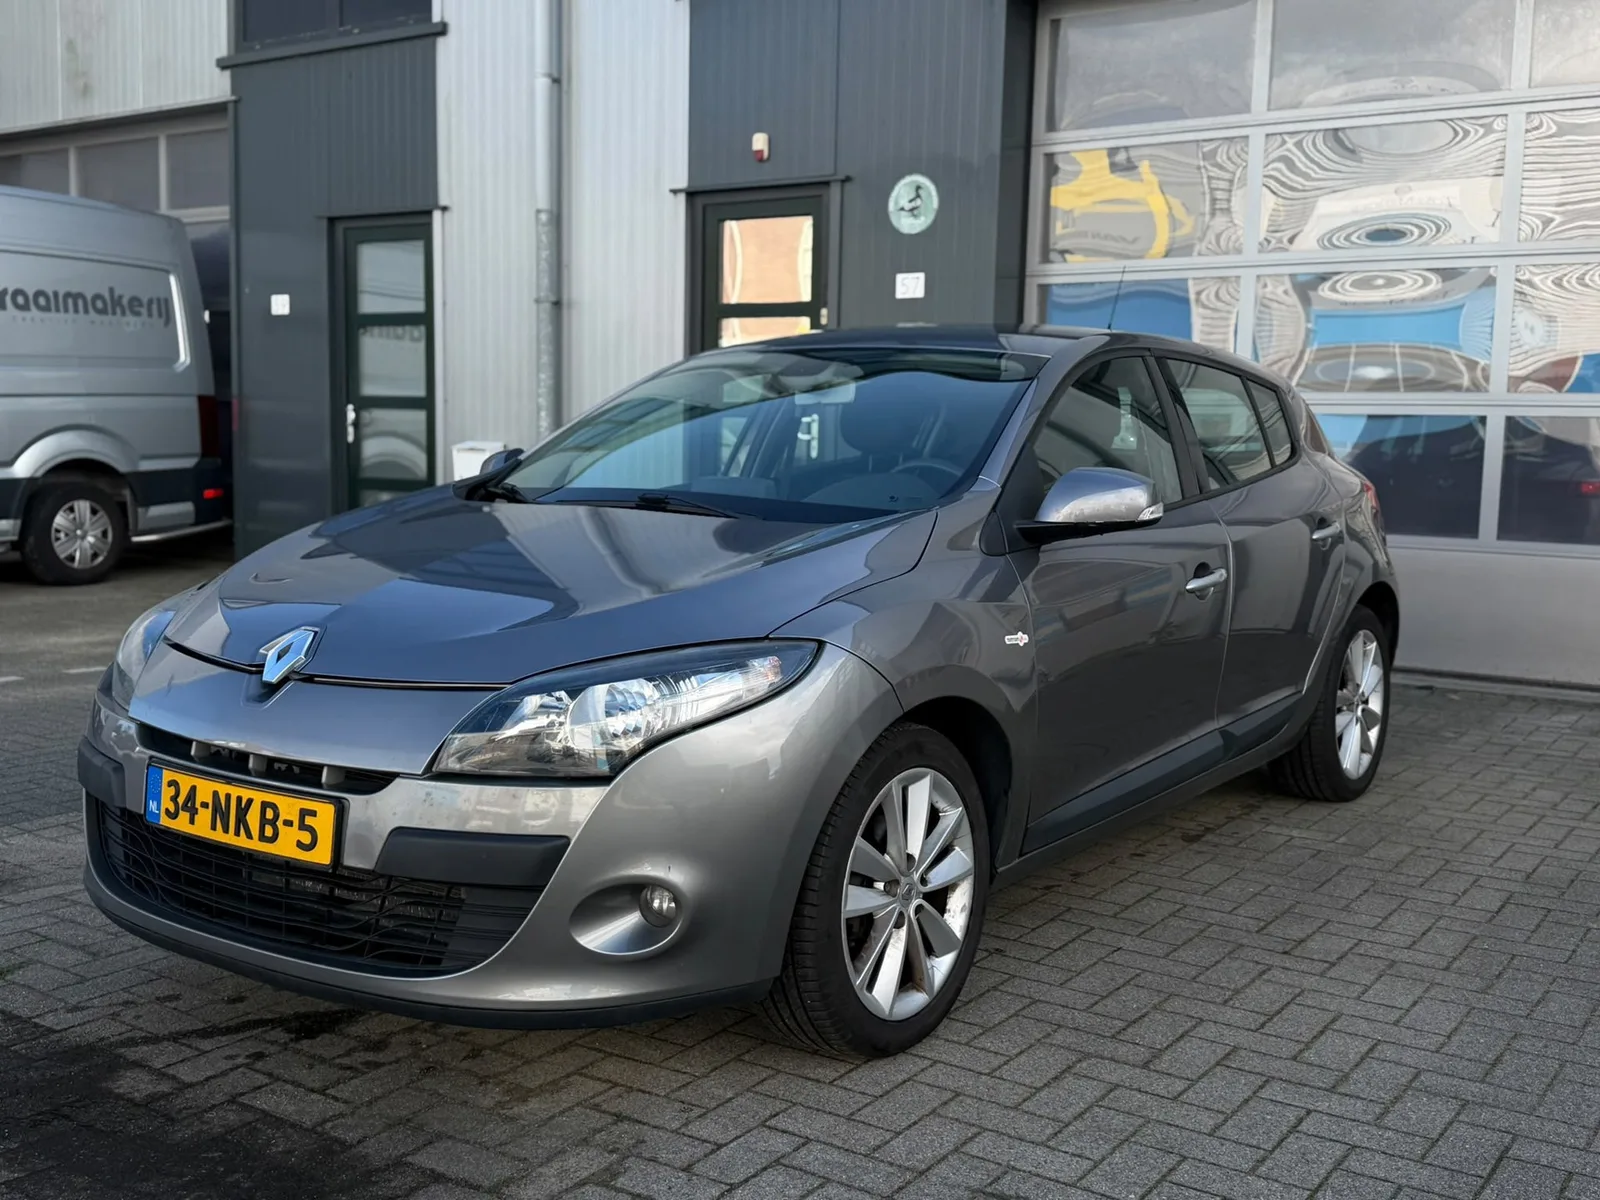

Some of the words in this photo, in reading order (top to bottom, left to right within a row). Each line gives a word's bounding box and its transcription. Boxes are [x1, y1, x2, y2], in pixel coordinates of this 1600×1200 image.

[899, 275, 921, 297] 57
[148, 801, 159, 814] NL
[164, 779, 319, 852] 34-NKB-5
